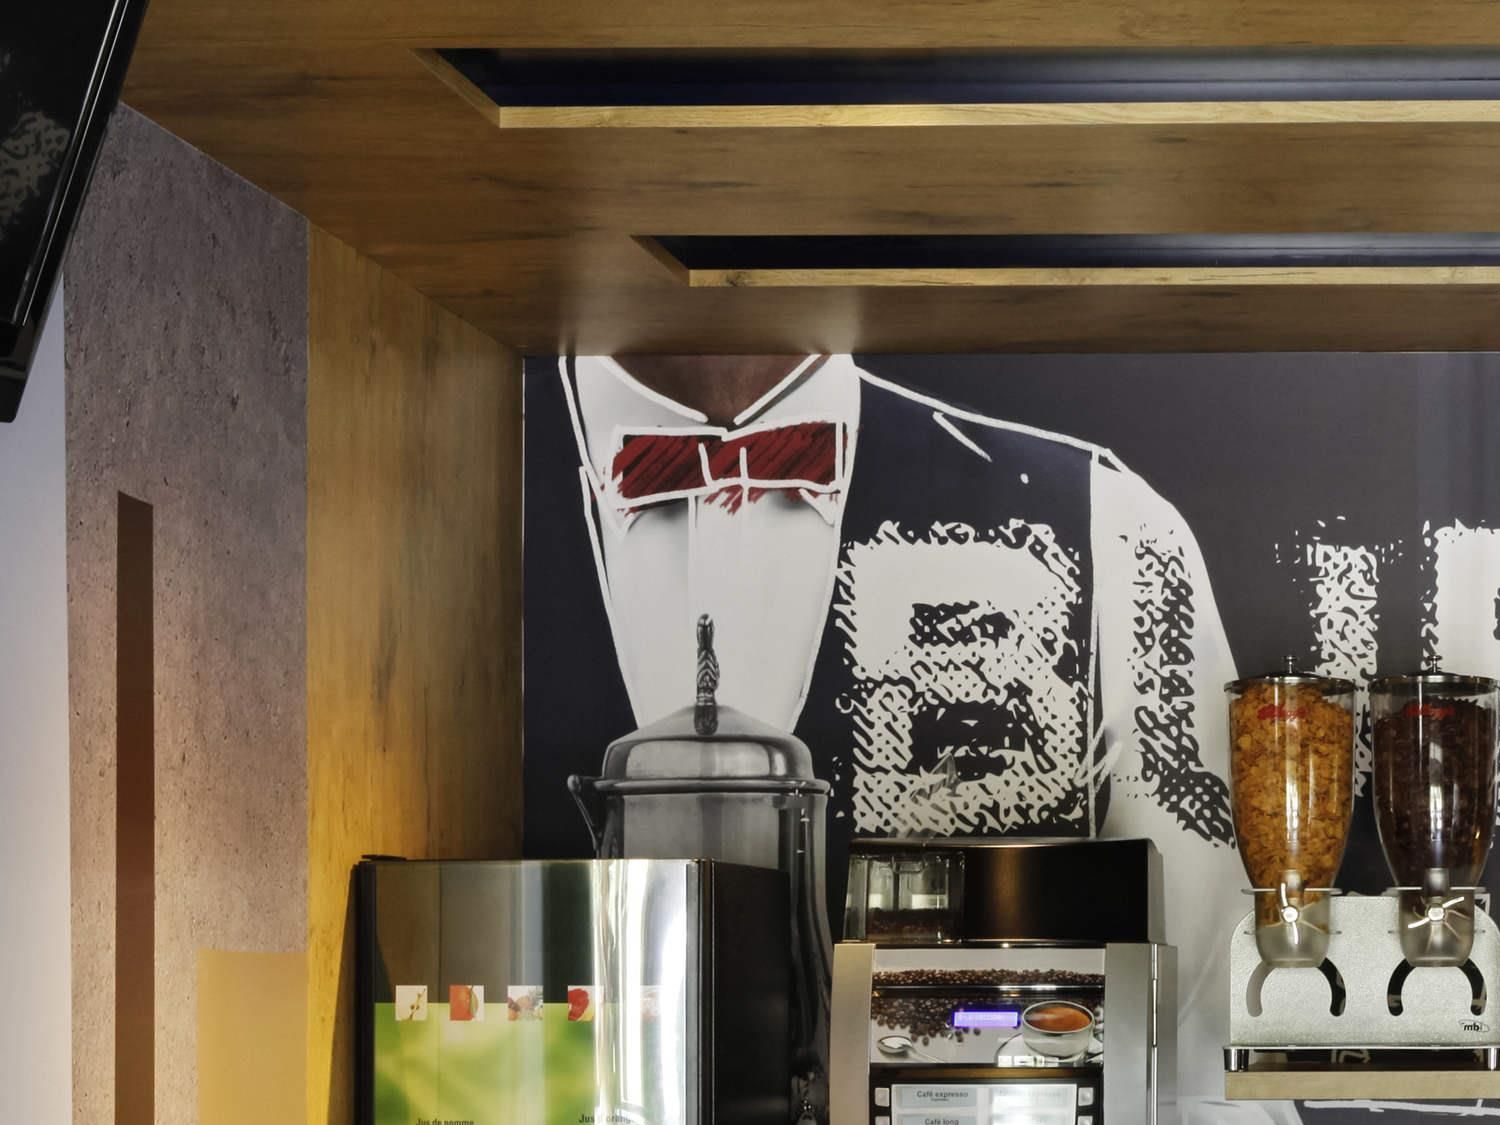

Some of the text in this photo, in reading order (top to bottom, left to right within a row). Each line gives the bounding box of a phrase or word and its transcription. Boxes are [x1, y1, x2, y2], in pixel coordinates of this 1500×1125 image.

[916, 1090, 969, 1099] Café expresso
[578, 1113, 595, 1124] Jus
[924, 1118, 941, 1125] Café
